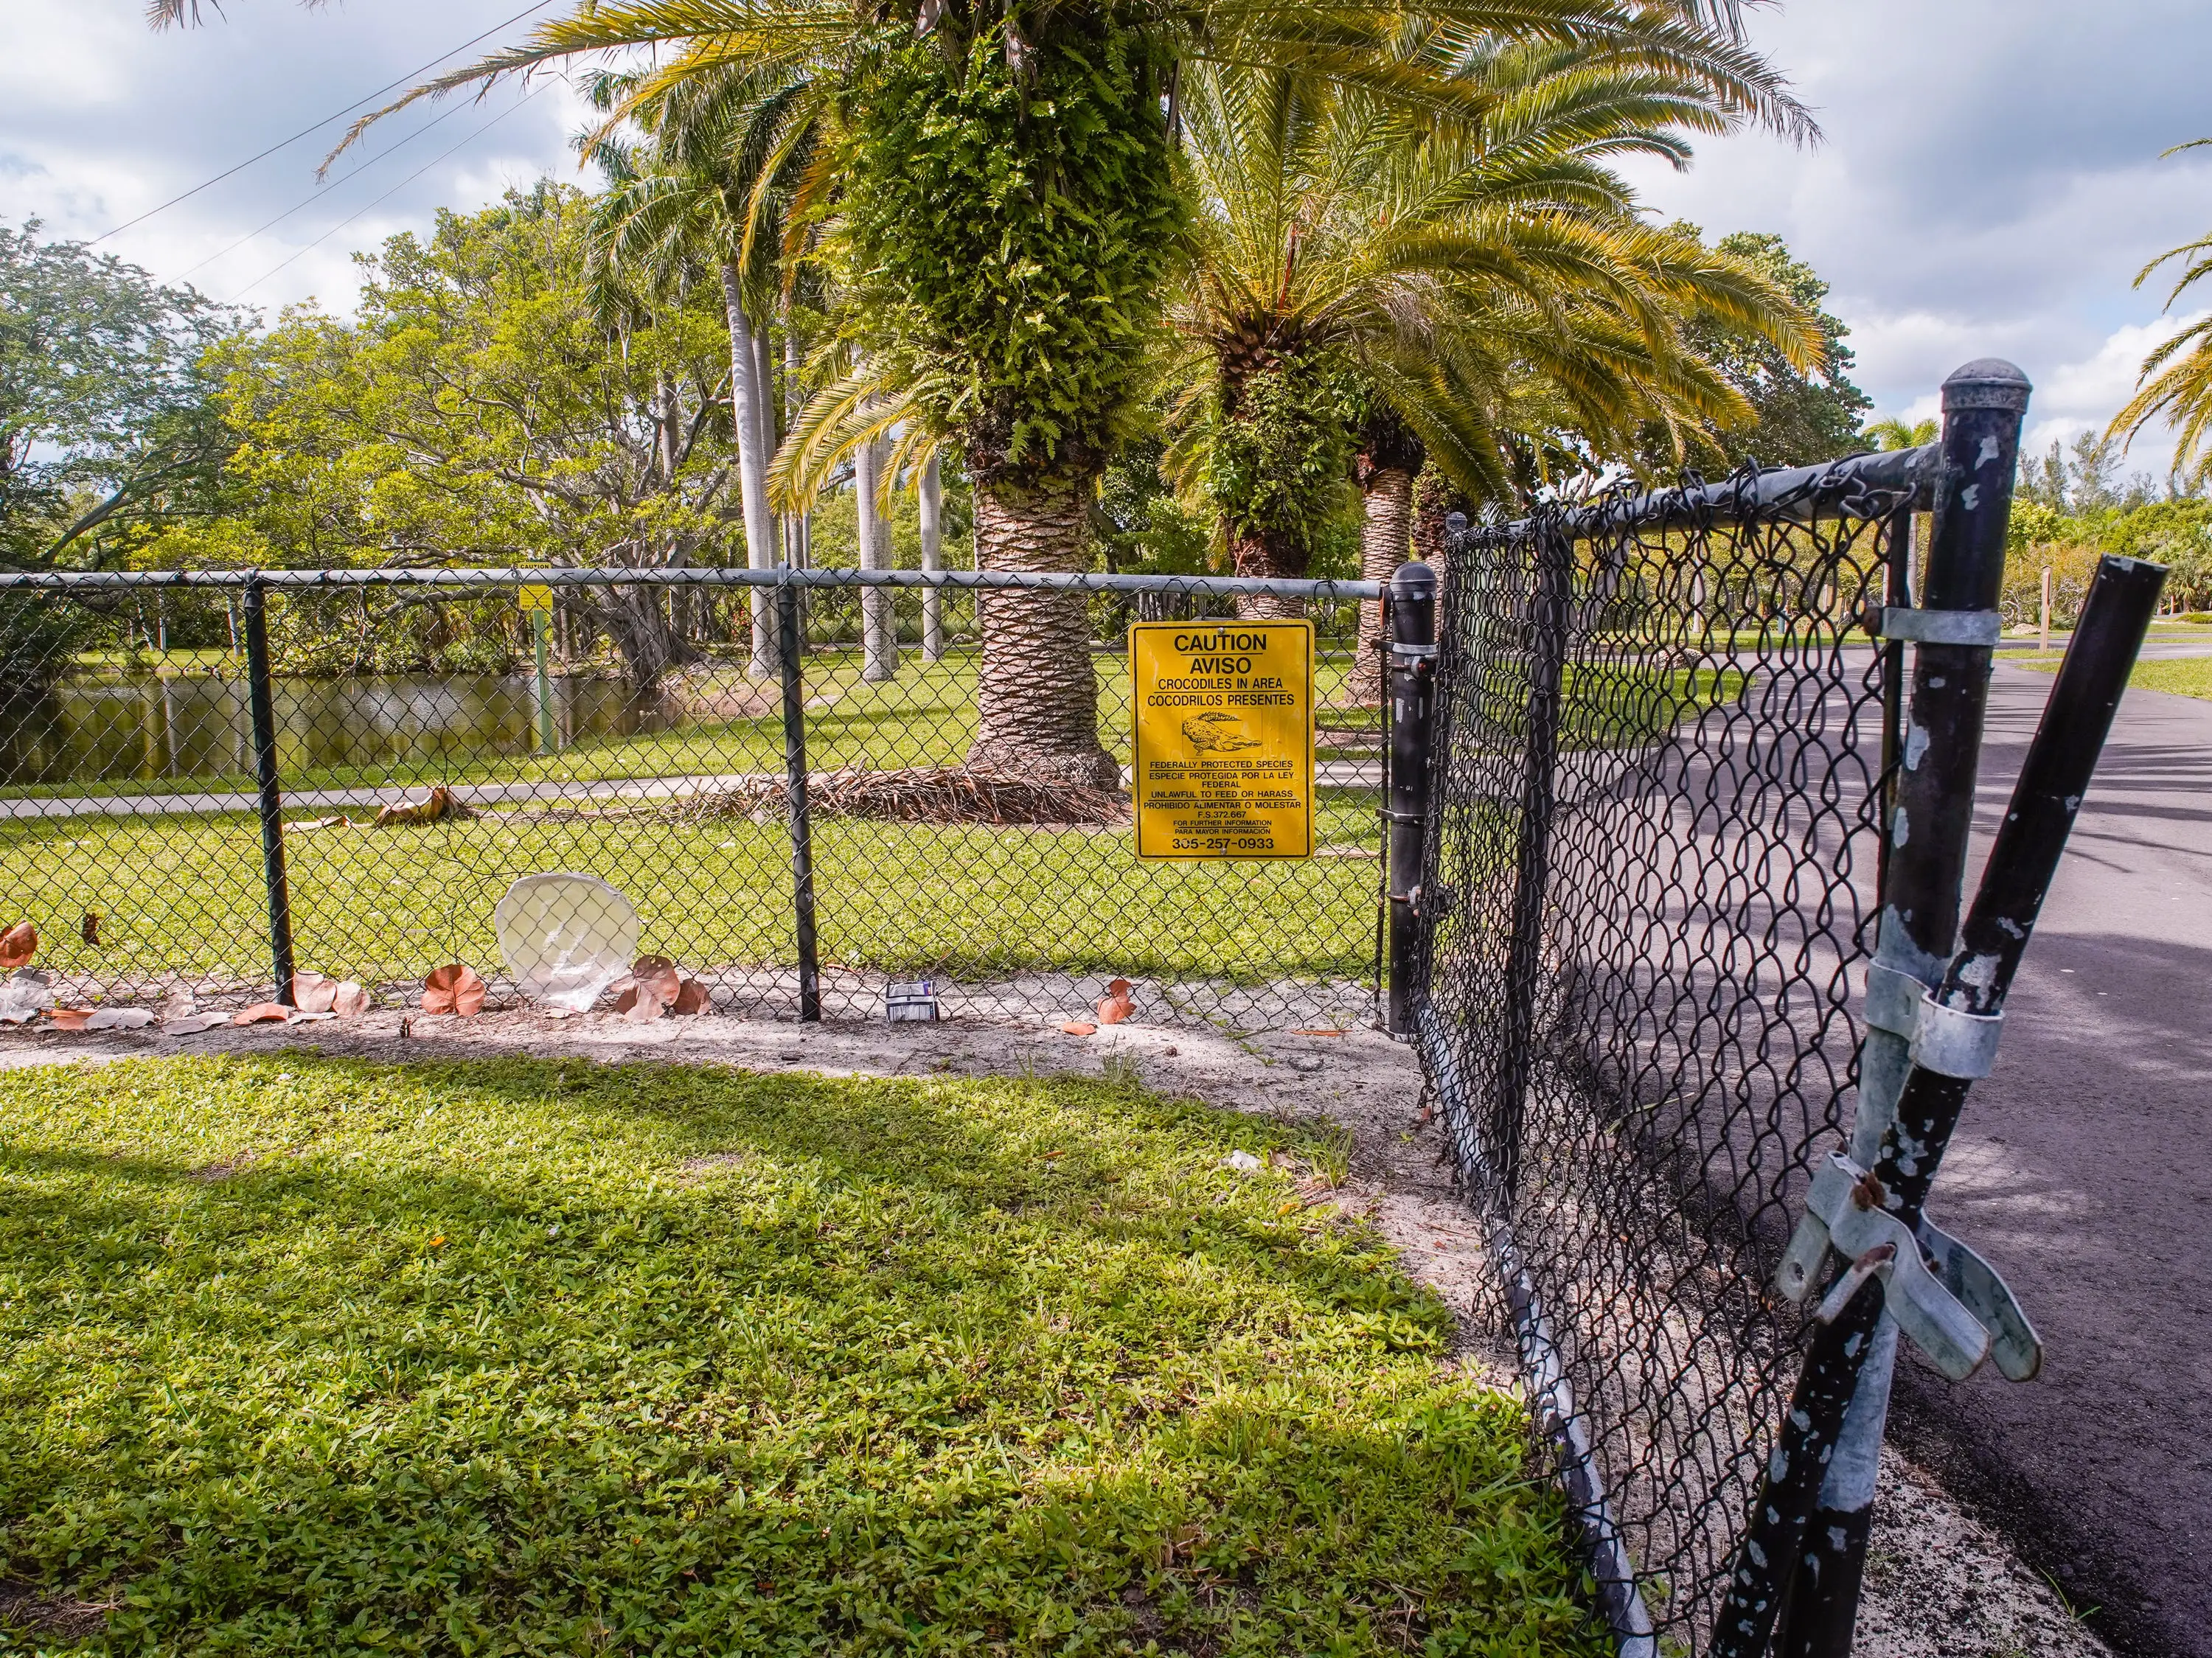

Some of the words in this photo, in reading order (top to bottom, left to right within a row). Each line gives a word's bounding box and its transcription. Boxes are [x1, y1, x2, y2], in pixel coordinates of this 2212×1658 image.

[1175, 634, 1266, 651] CAUTION
[1190, 658, 1251, 674] AVISO
[1158, 678, 1231, 689] CROCODILES
[1237, 678, 1248, 689] IN
[1253, 678, 1282, 688] AREA
[1148, 695, 1222, 706] COCODRILOS
[1228, 694, 1294, 705] PRESENTES
[1172, 838, 1273, 849] 305-257-0933
